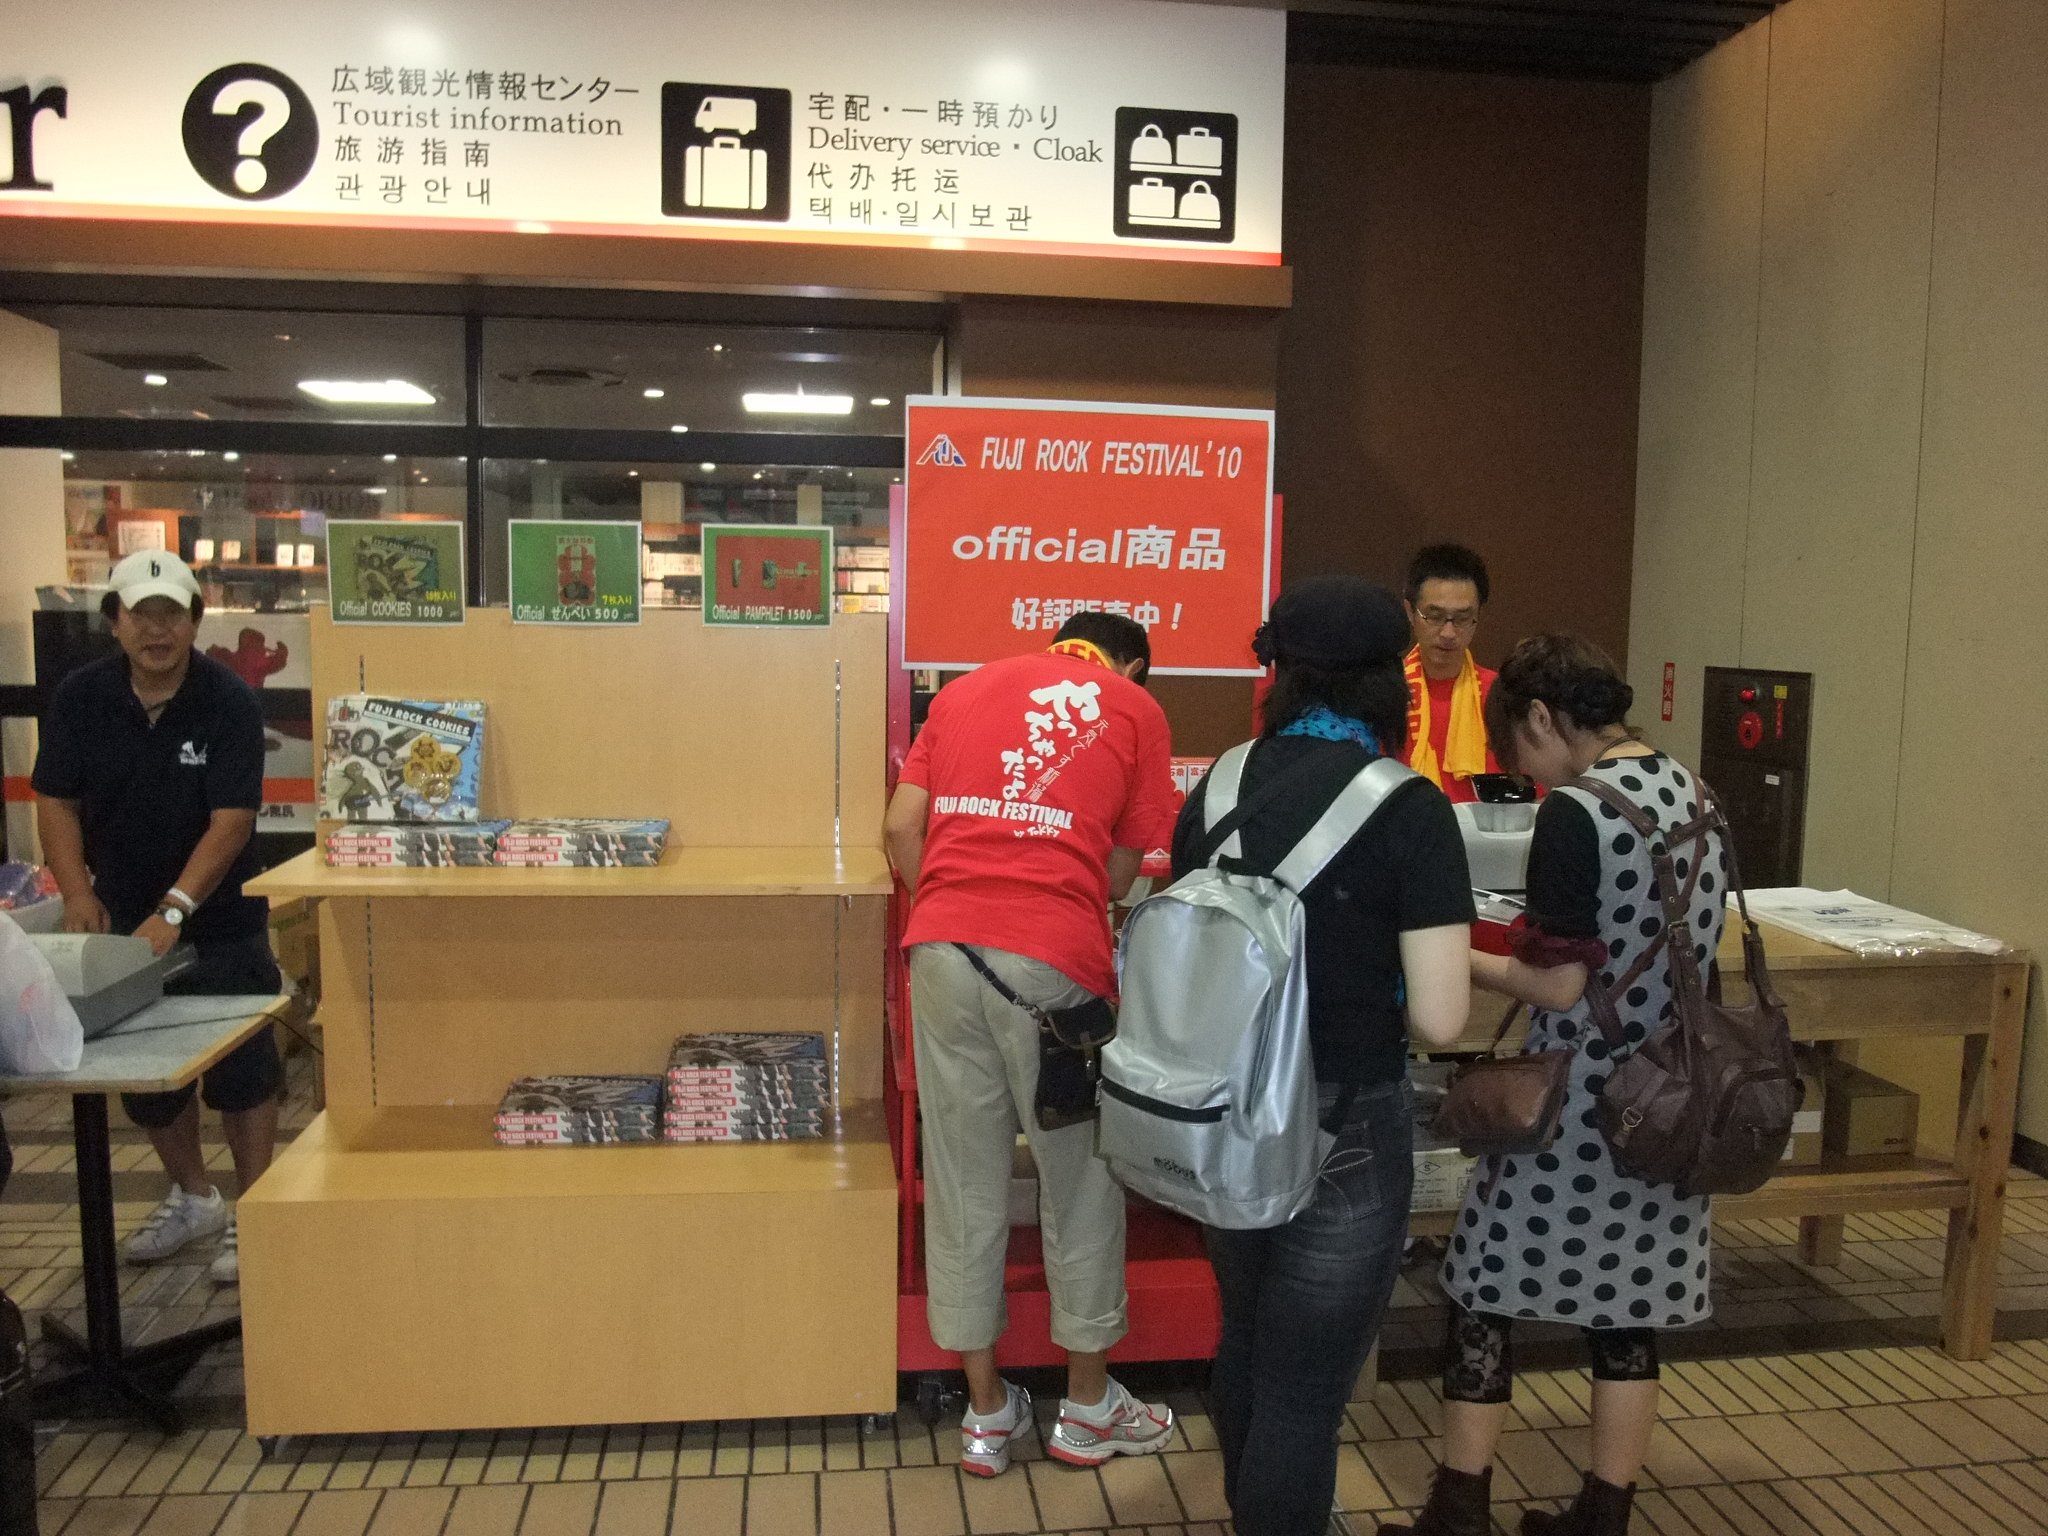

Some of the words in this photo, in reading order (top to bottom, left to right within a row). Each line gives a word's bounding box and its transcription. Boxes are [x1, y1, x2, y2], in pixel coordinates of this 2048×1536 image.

[332, 64, 640, 104] 広域観光情報センター
[333, 102, 440, 130] Tourist
[450, 104, 624, 137] information
[334, 136, 490, 168] 旅游指南
[808, 127, 912, 160] Delivery
[920, 135, 1001, 158] service
[1033, 138, 1104, 163] Cloak
[335, 174, 491, 206] 관광안내
[807, 161, 960, 194] 代办托运
[980, 437, 1026, 471] FUJI
[1035, 439, 1092, 473] ROCK
[340, 601, 367, 616] Official
[372, 602, 411, 616] COOKIES
[418, 606, 443, 617] 1000
[516, 605, 545, 620] Official
[595, 608, 619, 619] 500
[712, 605, 740, 619] Official
[745, 606, 784, 621] PAMPHLET
[788, 609, 812, 620] 1500
[367, 702, 394, 717] FUJI
[395, 709, 424, 724] ROCK
[426, 716, 471, 736] COOKIES
[934, 796, 957, 814] FUJI
[957, 796, 1002, 817] ROCK
[1002, 801, 1073, 830] FESTIVAL
[1013, 829, 1025, 838] by
